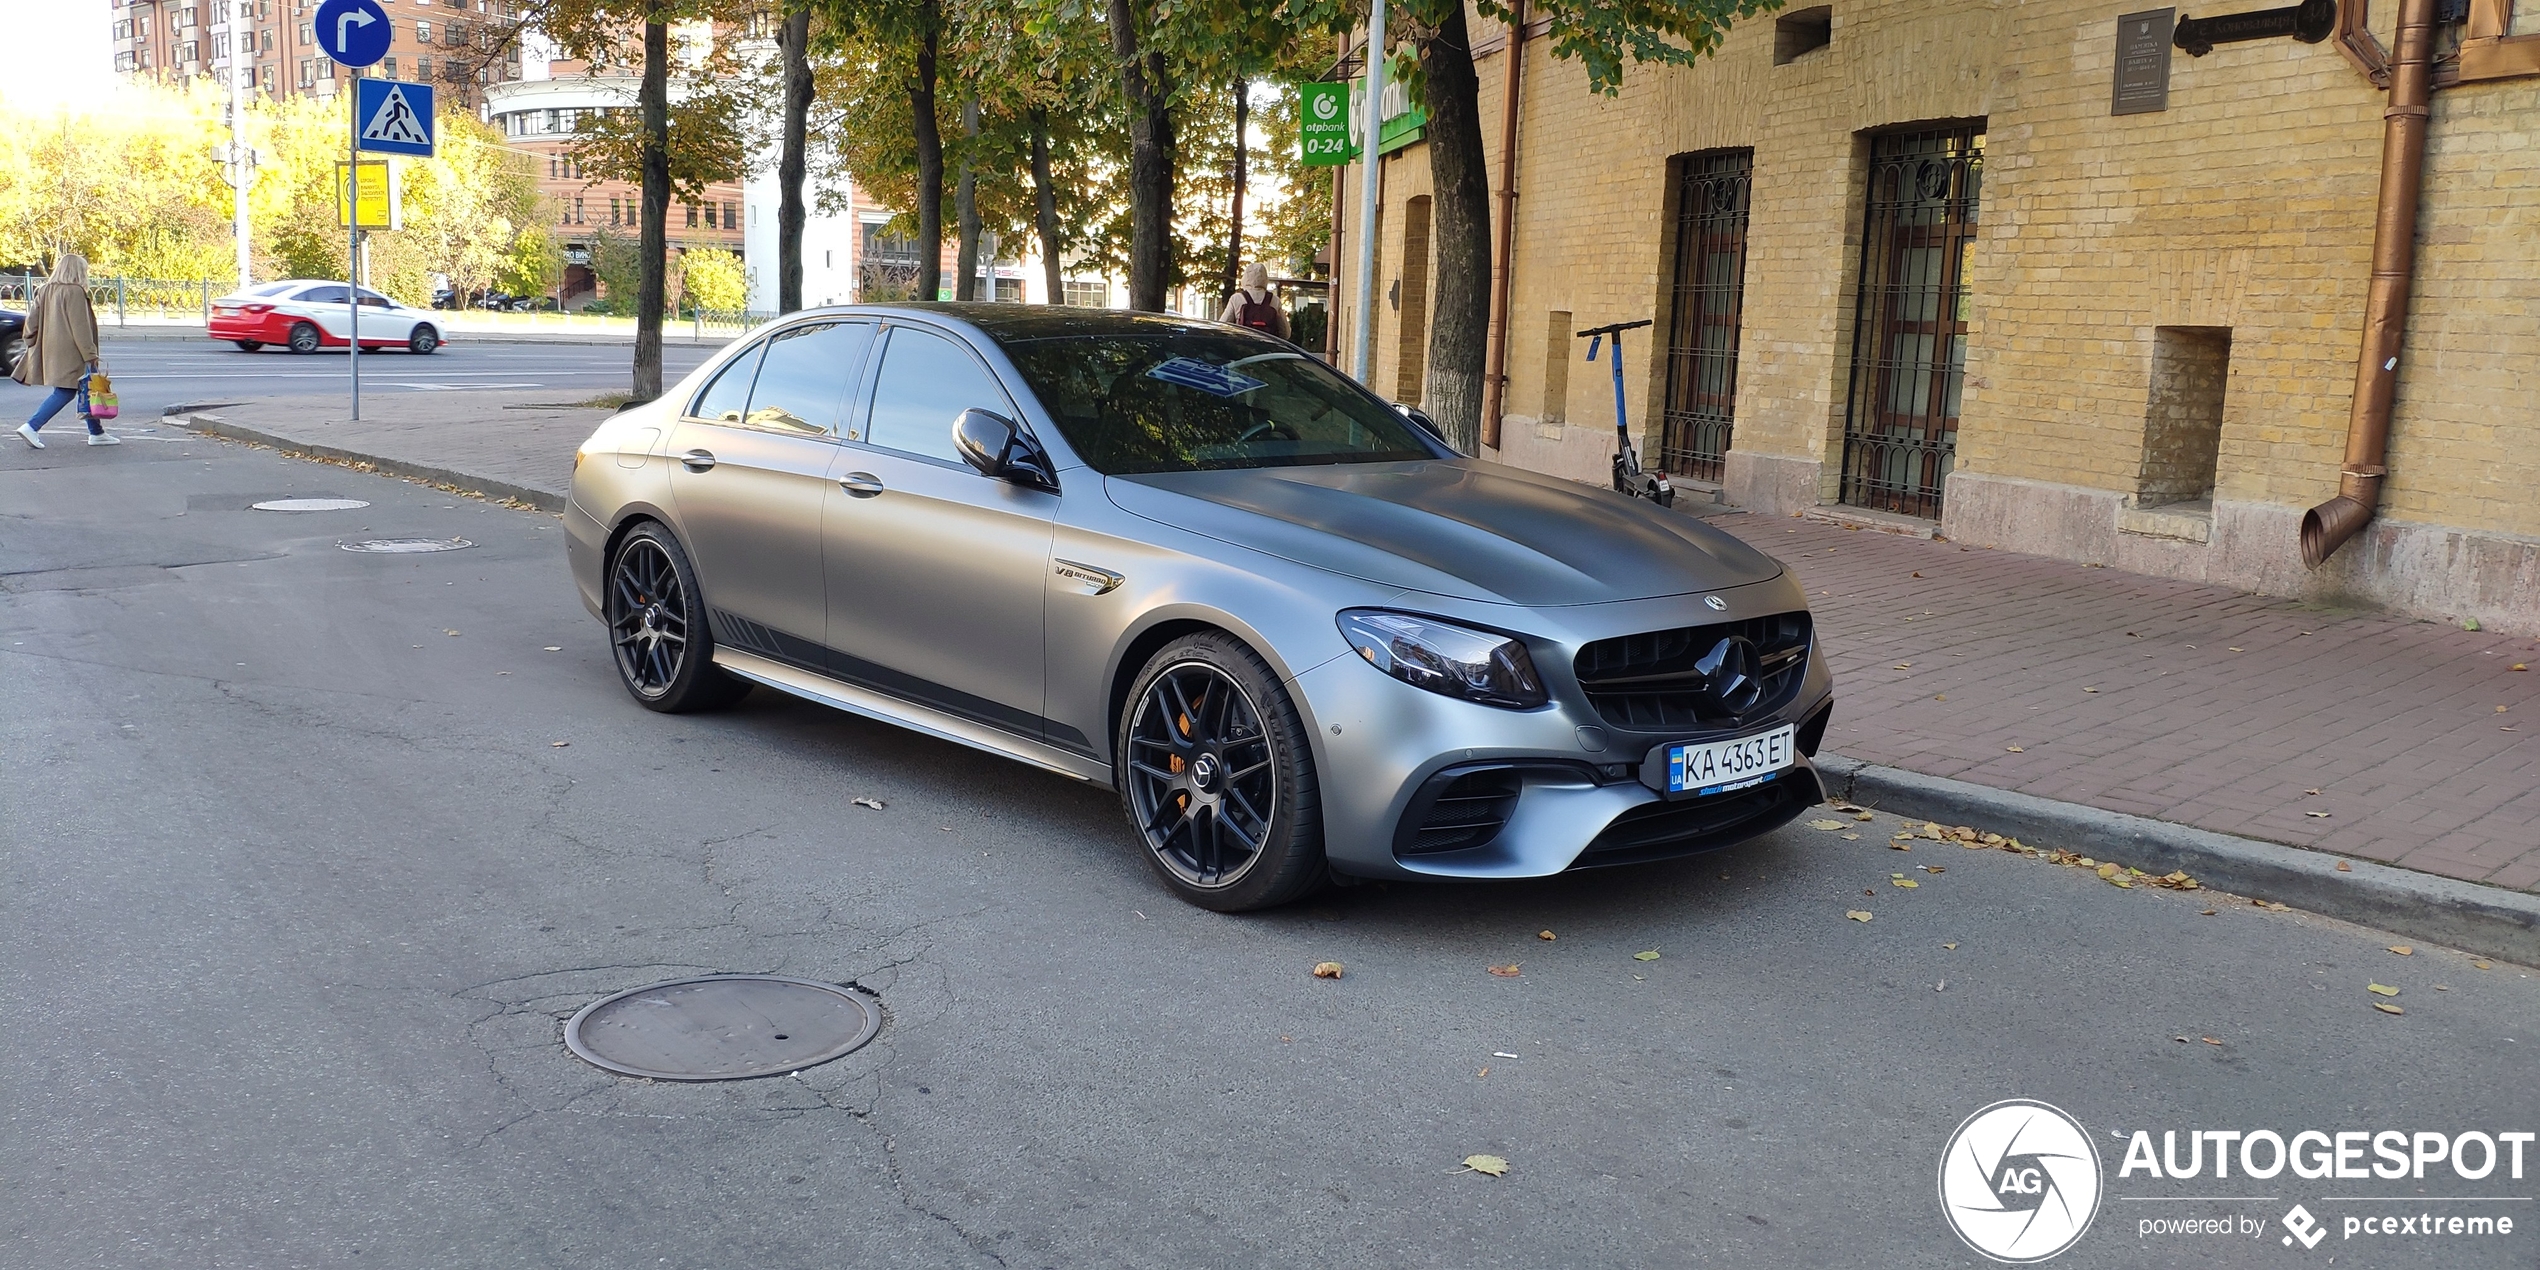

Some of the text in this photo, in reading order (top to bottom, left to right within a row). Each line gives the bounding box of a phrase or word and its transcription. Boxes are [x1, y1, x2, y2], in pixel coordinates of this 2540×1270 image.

[2303, 2, 2327, 22] 44
[2214, 16, 2291, 35] Коновальця
[1306, 122, 1345, 134] otpbank
[1307, 138, 1345, 154] 0-24
[1055, 566, 1106, 584] V8 BITURBO
[1685, 731, 1790, 783] KA 4363 ET
[1671, 774, 1683, 786] UA
